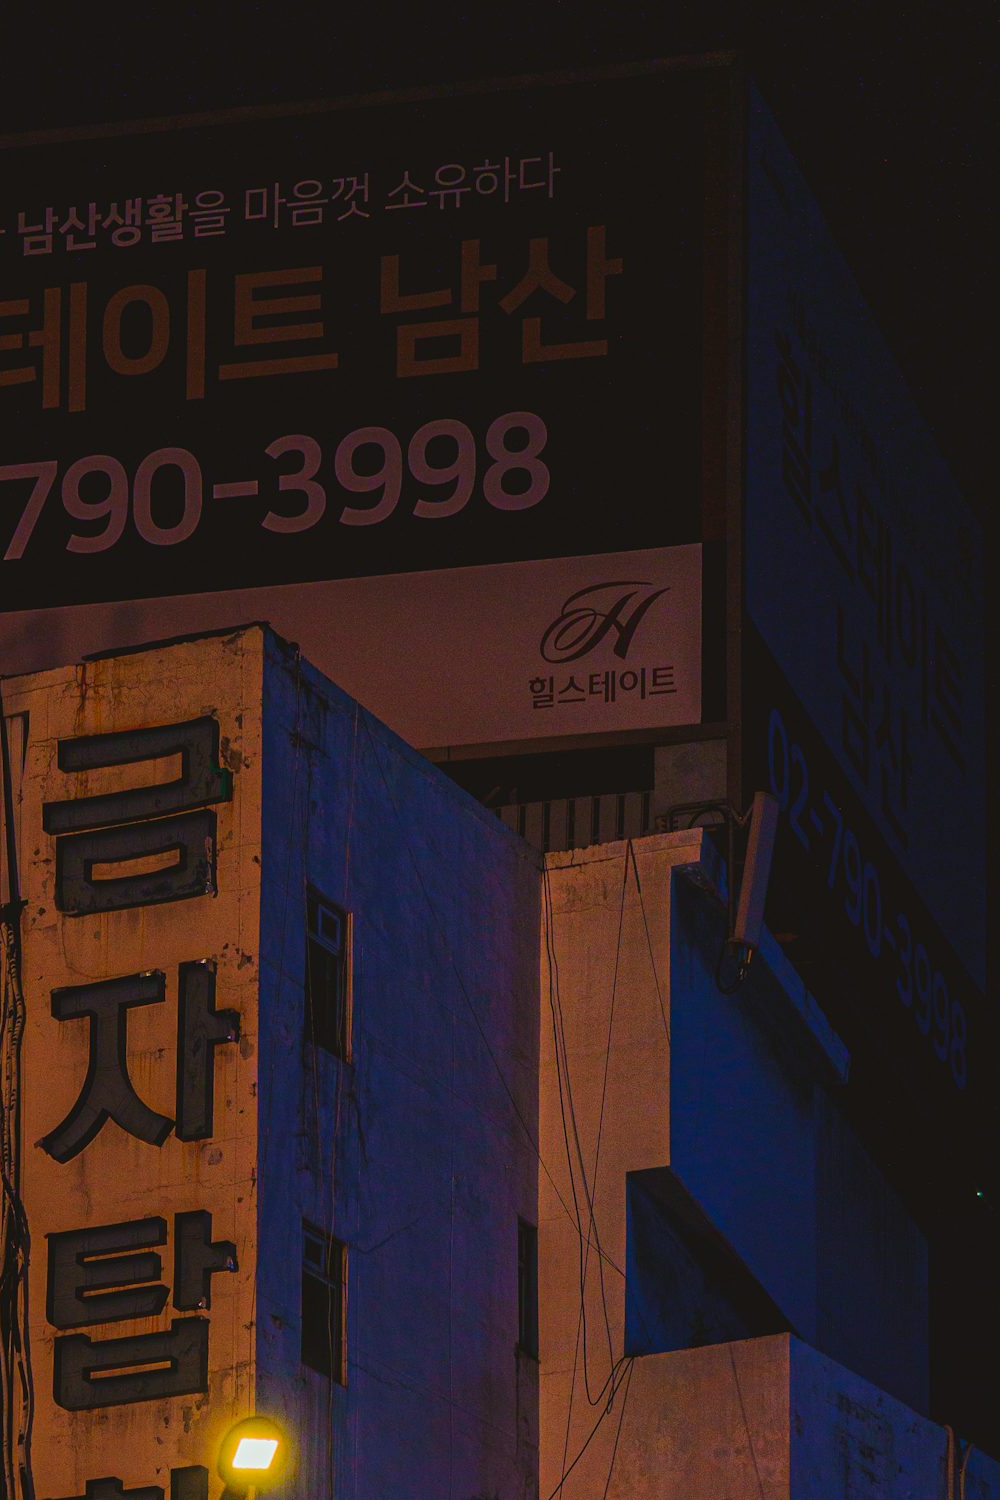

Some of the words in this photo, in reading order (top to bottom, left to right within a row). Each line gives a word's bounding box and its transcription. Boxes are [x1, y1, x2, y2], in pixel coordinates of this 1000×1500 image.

[16, 192, 231, 257] 남산생활을
[243, 171, 371, 229] 마음껏
[384, 150, 562, 211] 소유하다
[379, 224, 624, 379] 남산
[528, 666, 678, 710] 힐스테이트
[767, 706, 968, 1092] 02-790-3998
